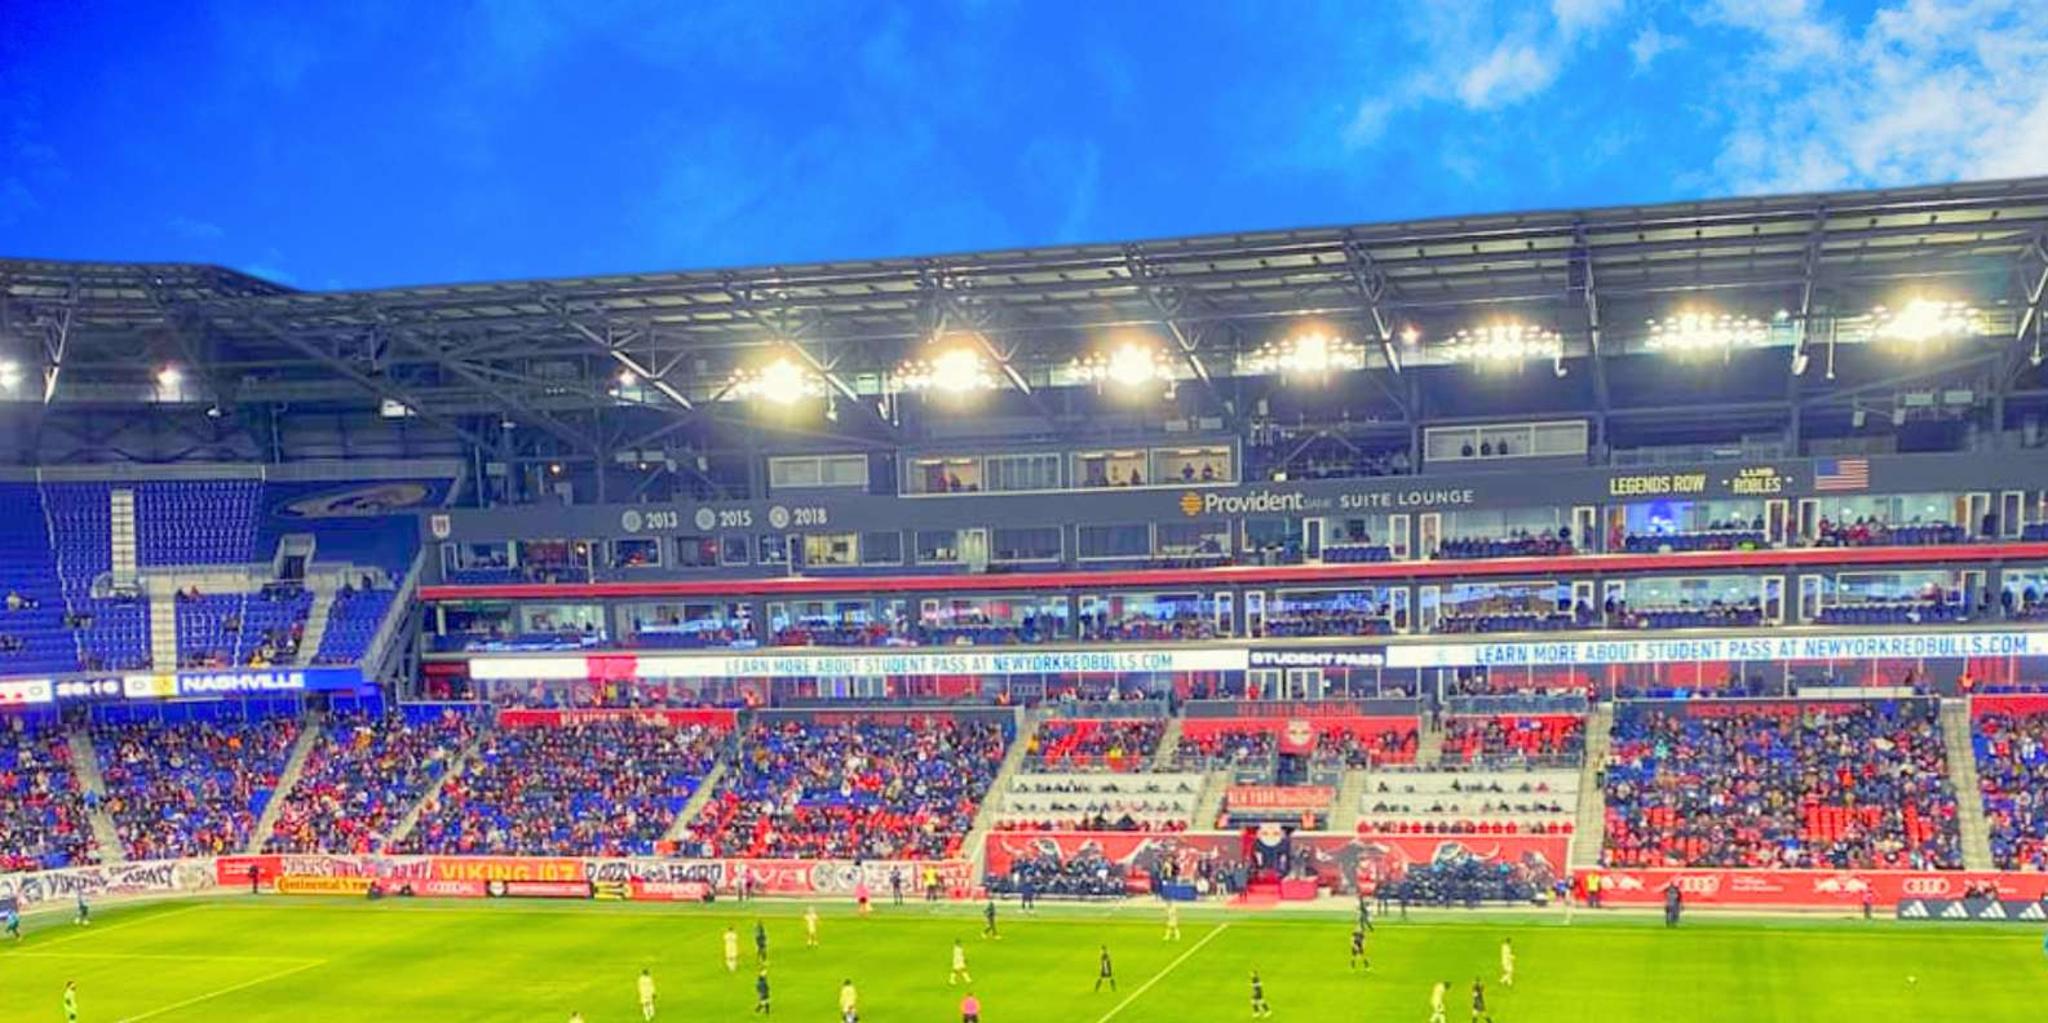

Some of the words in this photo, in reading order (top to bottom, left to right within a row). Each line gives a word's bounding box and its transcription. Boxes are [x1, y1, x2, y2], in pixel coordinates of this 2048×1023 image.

[1610, 477, 1671, 494] LEGENDS
[1674, 474, 1706, 491] ROW
[1733, 478, 1781, 493] ROBLES
[1205, 491, 1303, 513] Provident
[1340, 493, 1392, 508] SUITE
[1399, 490, 1474, 505] LOUNGE
[645, 512, 677, 528] 2013
[720, 511, 752, 527] 2015
[794, 508, 827, 525] 2018
[1475, 646, 1527, 663] LEARN
[1534, 644, 1578, 662] MORE
[1585, 643, 1639, 661] ABOUT
[1646, 641, 1721, 660] STUDENT
[1730, 640, 1772, 659] PASS
[1778, 640, 1797, 657] AT
[1805, 635, 2028, 657] NEWYORKREDBULLS.COM
[725, 659, 769, 673] LEARN
[775, 658, 808, 672] MORE
[816, 658, 860, 672] ABOUT
[866, 657, 928, 672] STUDENT
[932, 657, 967, 671] PASS
[972, 656, 988, 670] AT
[993, 654, 1173, 670] NEWYORKREDBULLS.COM
[1251, 652, 1334, 665] STUDENT
[1335, 652, 1383, 664] PASS
[183, 673, 304, 692] NASHVILLE
[440, 862, 530, 881] VIKING
